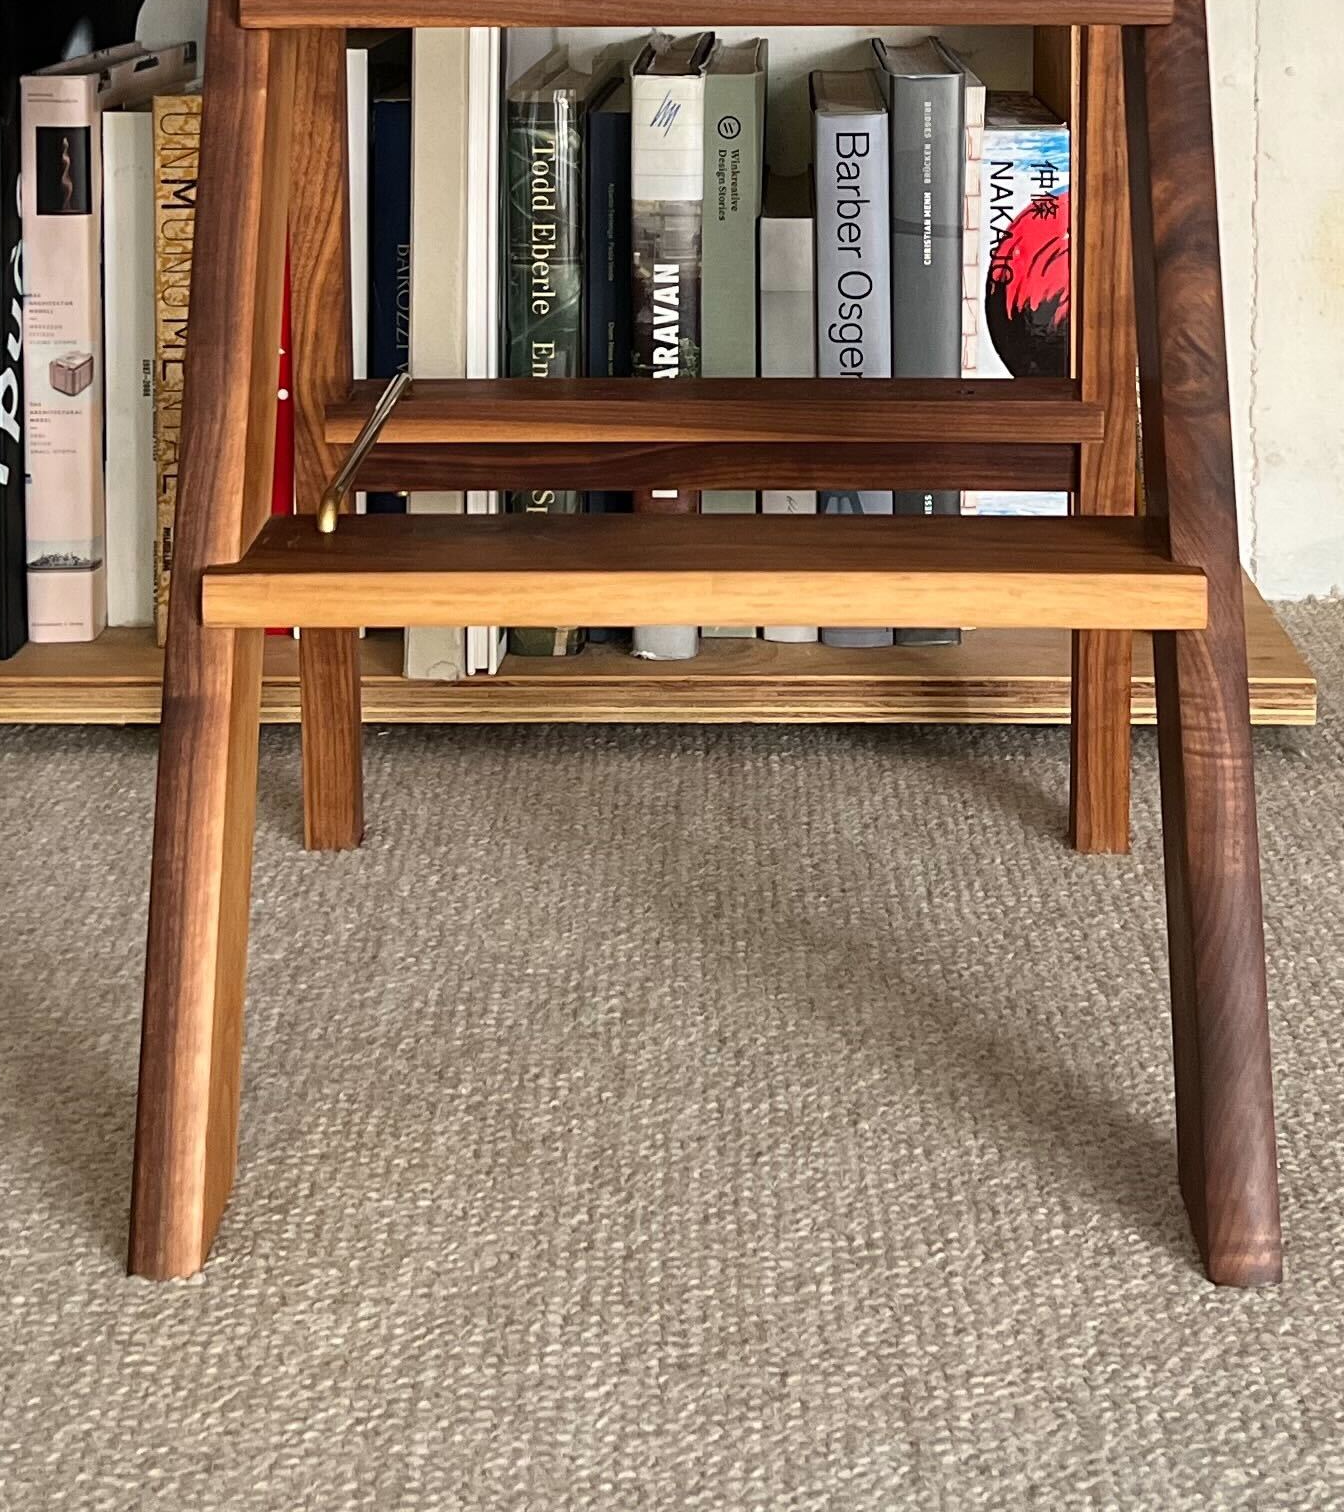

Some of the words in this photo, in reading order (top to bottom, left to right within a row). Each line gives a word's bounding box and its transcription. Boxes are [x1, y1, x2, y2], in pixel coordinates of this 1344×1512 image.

[531, 140, 556, 211] Todd
[731, 148, 740, 213] Winkreative
[530, 223, 557, 316] Eberle
[923, 216, 932, 266] CHRISTIAN
